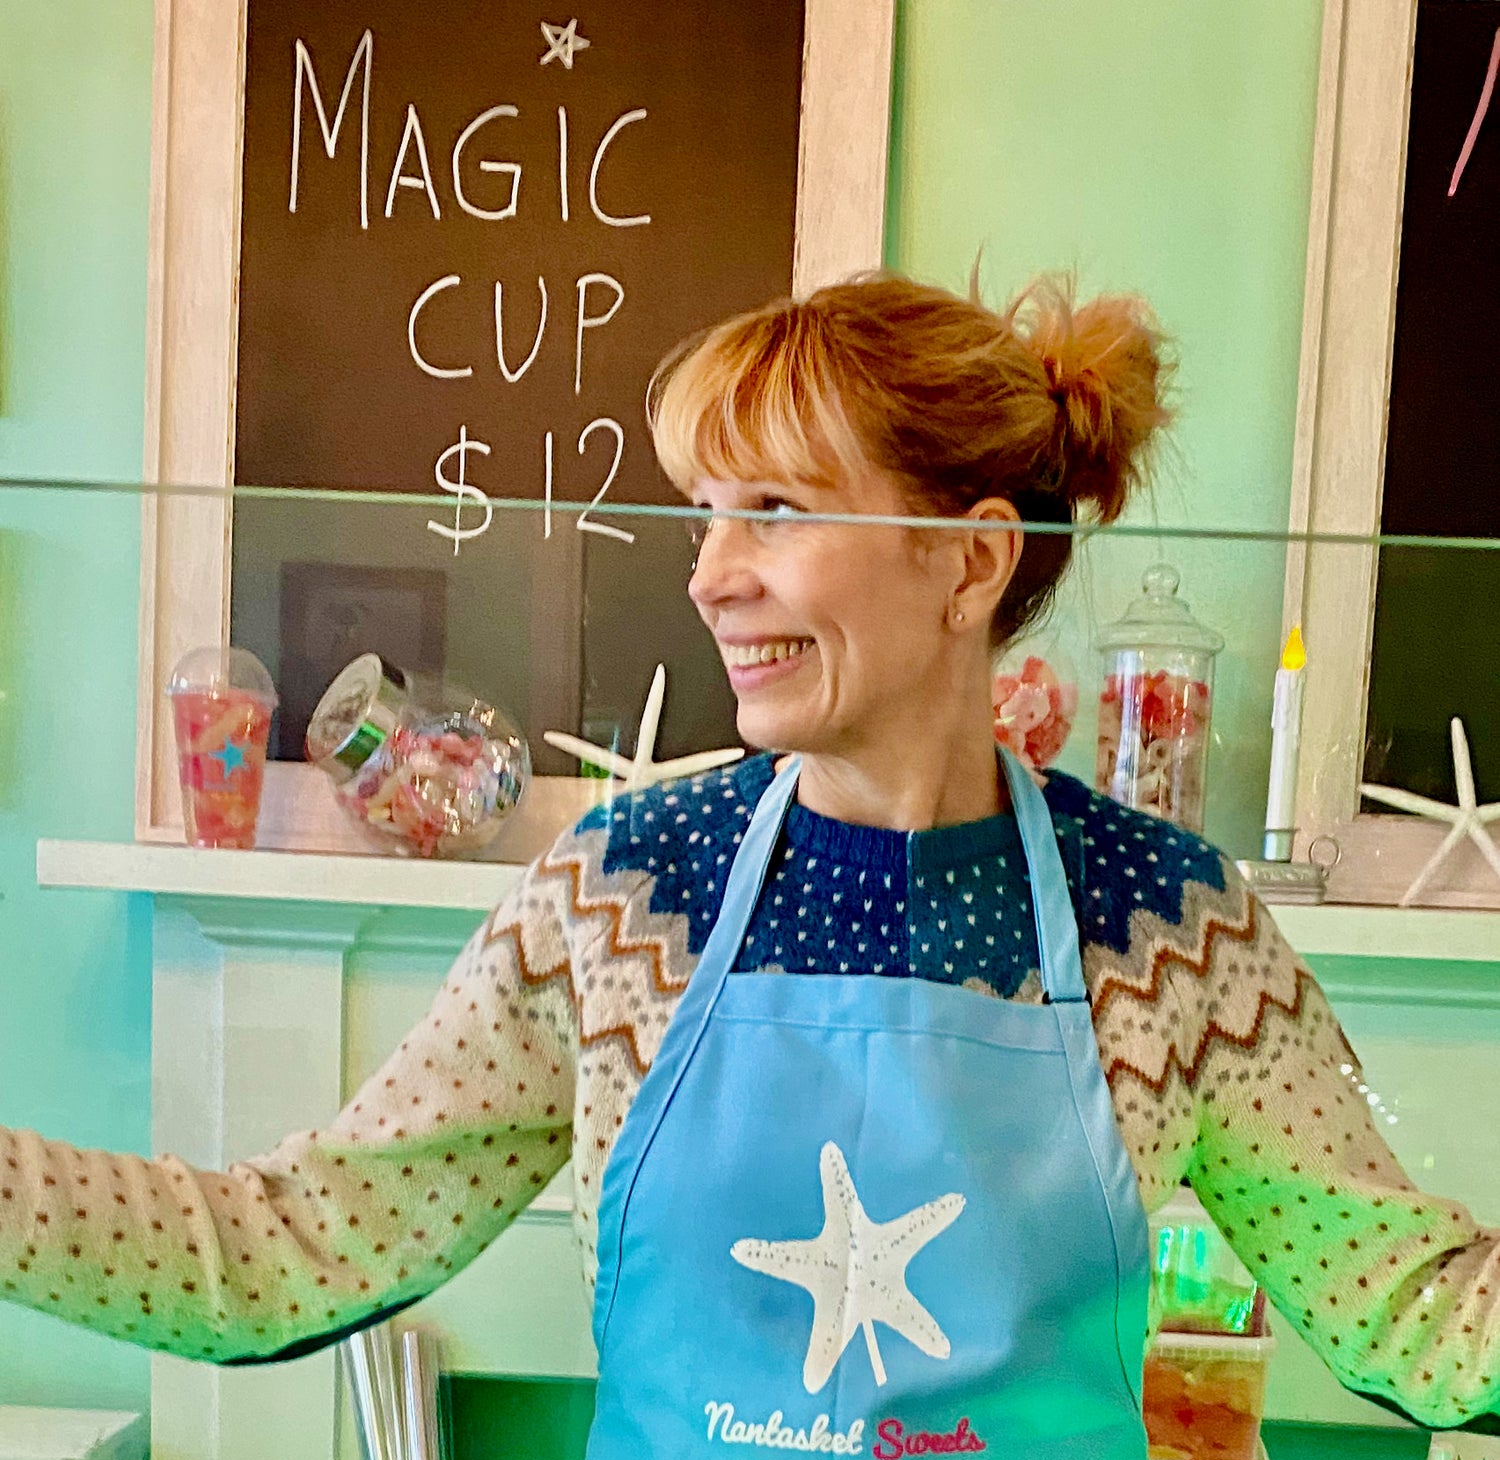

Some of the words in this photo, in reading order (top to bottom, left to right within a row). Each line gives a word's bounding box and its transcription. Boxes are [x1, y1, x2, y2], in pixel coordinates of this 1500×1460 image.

[289, 29, 651, 229] MAGIC
[408, 272, 625, 394] CUP
[705, 1400, 865, 1455] Nantasket
